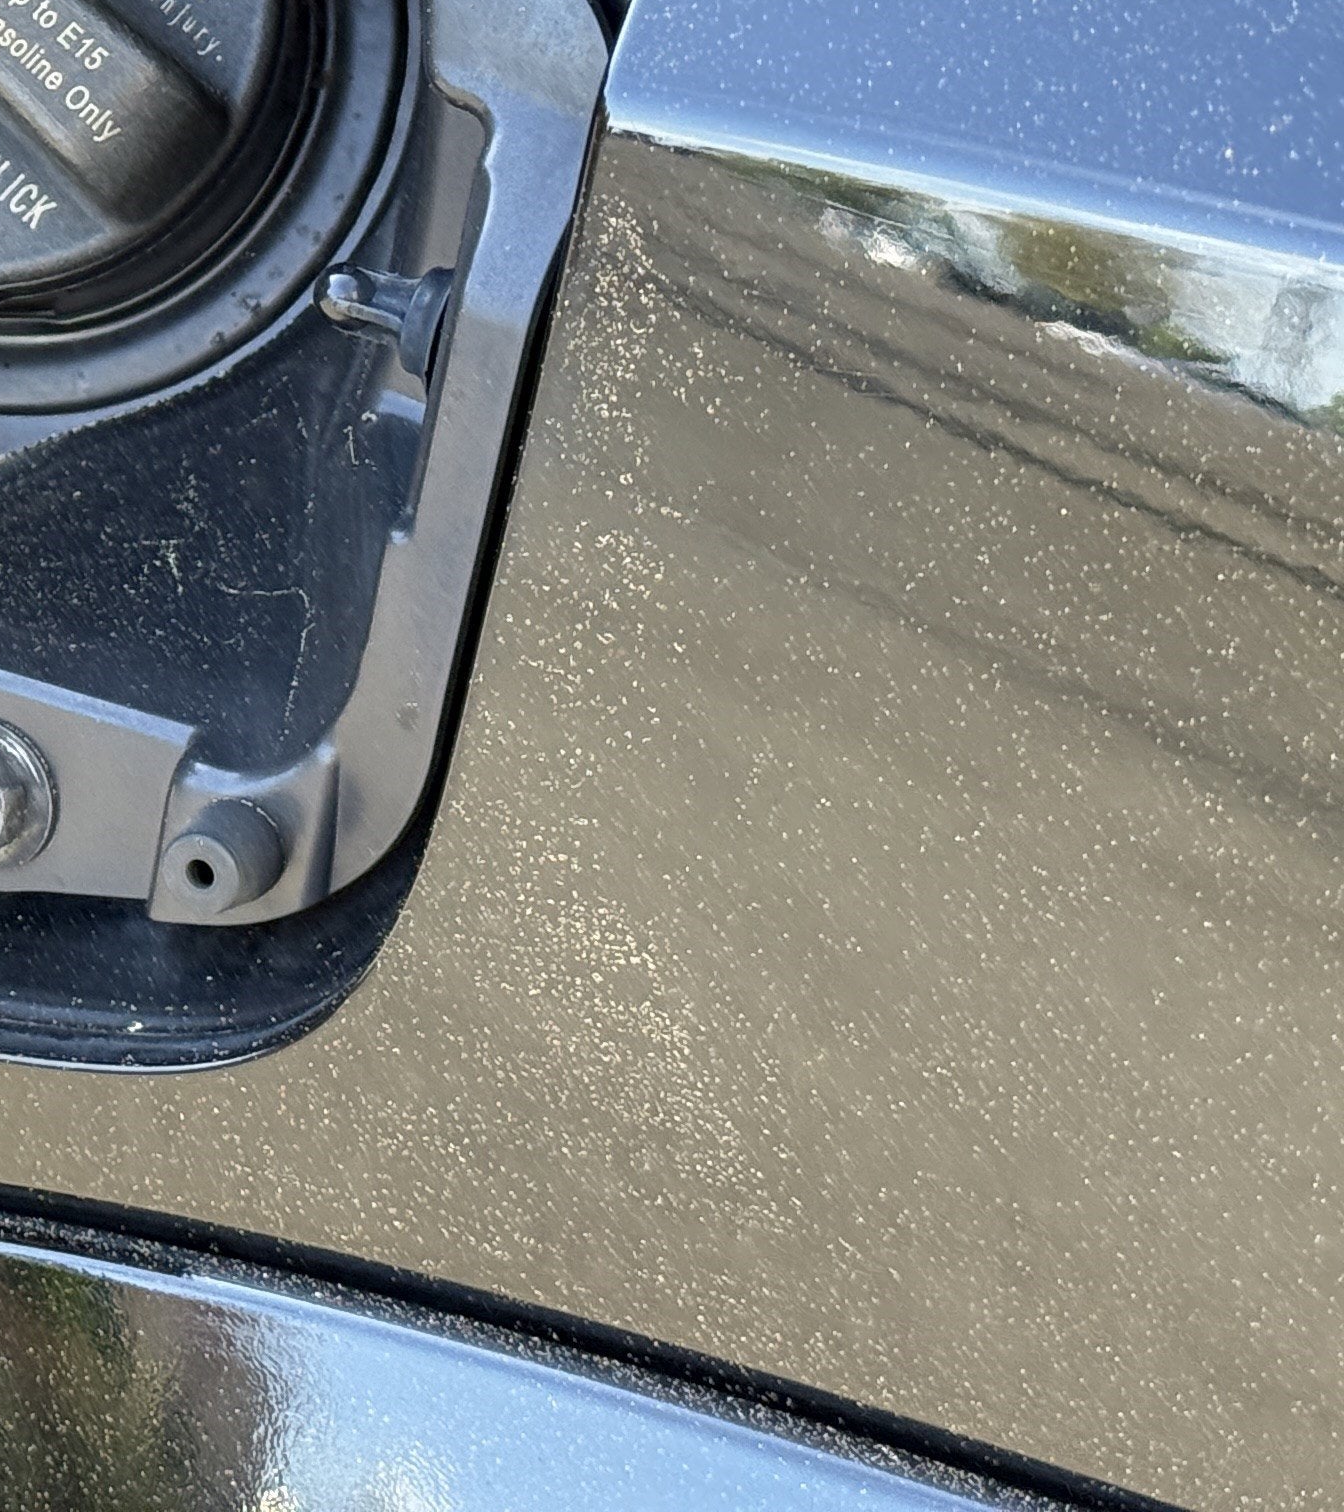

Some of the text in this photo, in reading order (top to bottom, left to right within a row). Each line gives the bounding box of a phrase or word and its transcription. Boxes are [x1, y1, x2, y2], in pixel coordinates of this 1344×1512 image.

[32, 0, 58, 29] to
[56, 21, 110, 71] E15
[65, 85, 122, 144] Only
